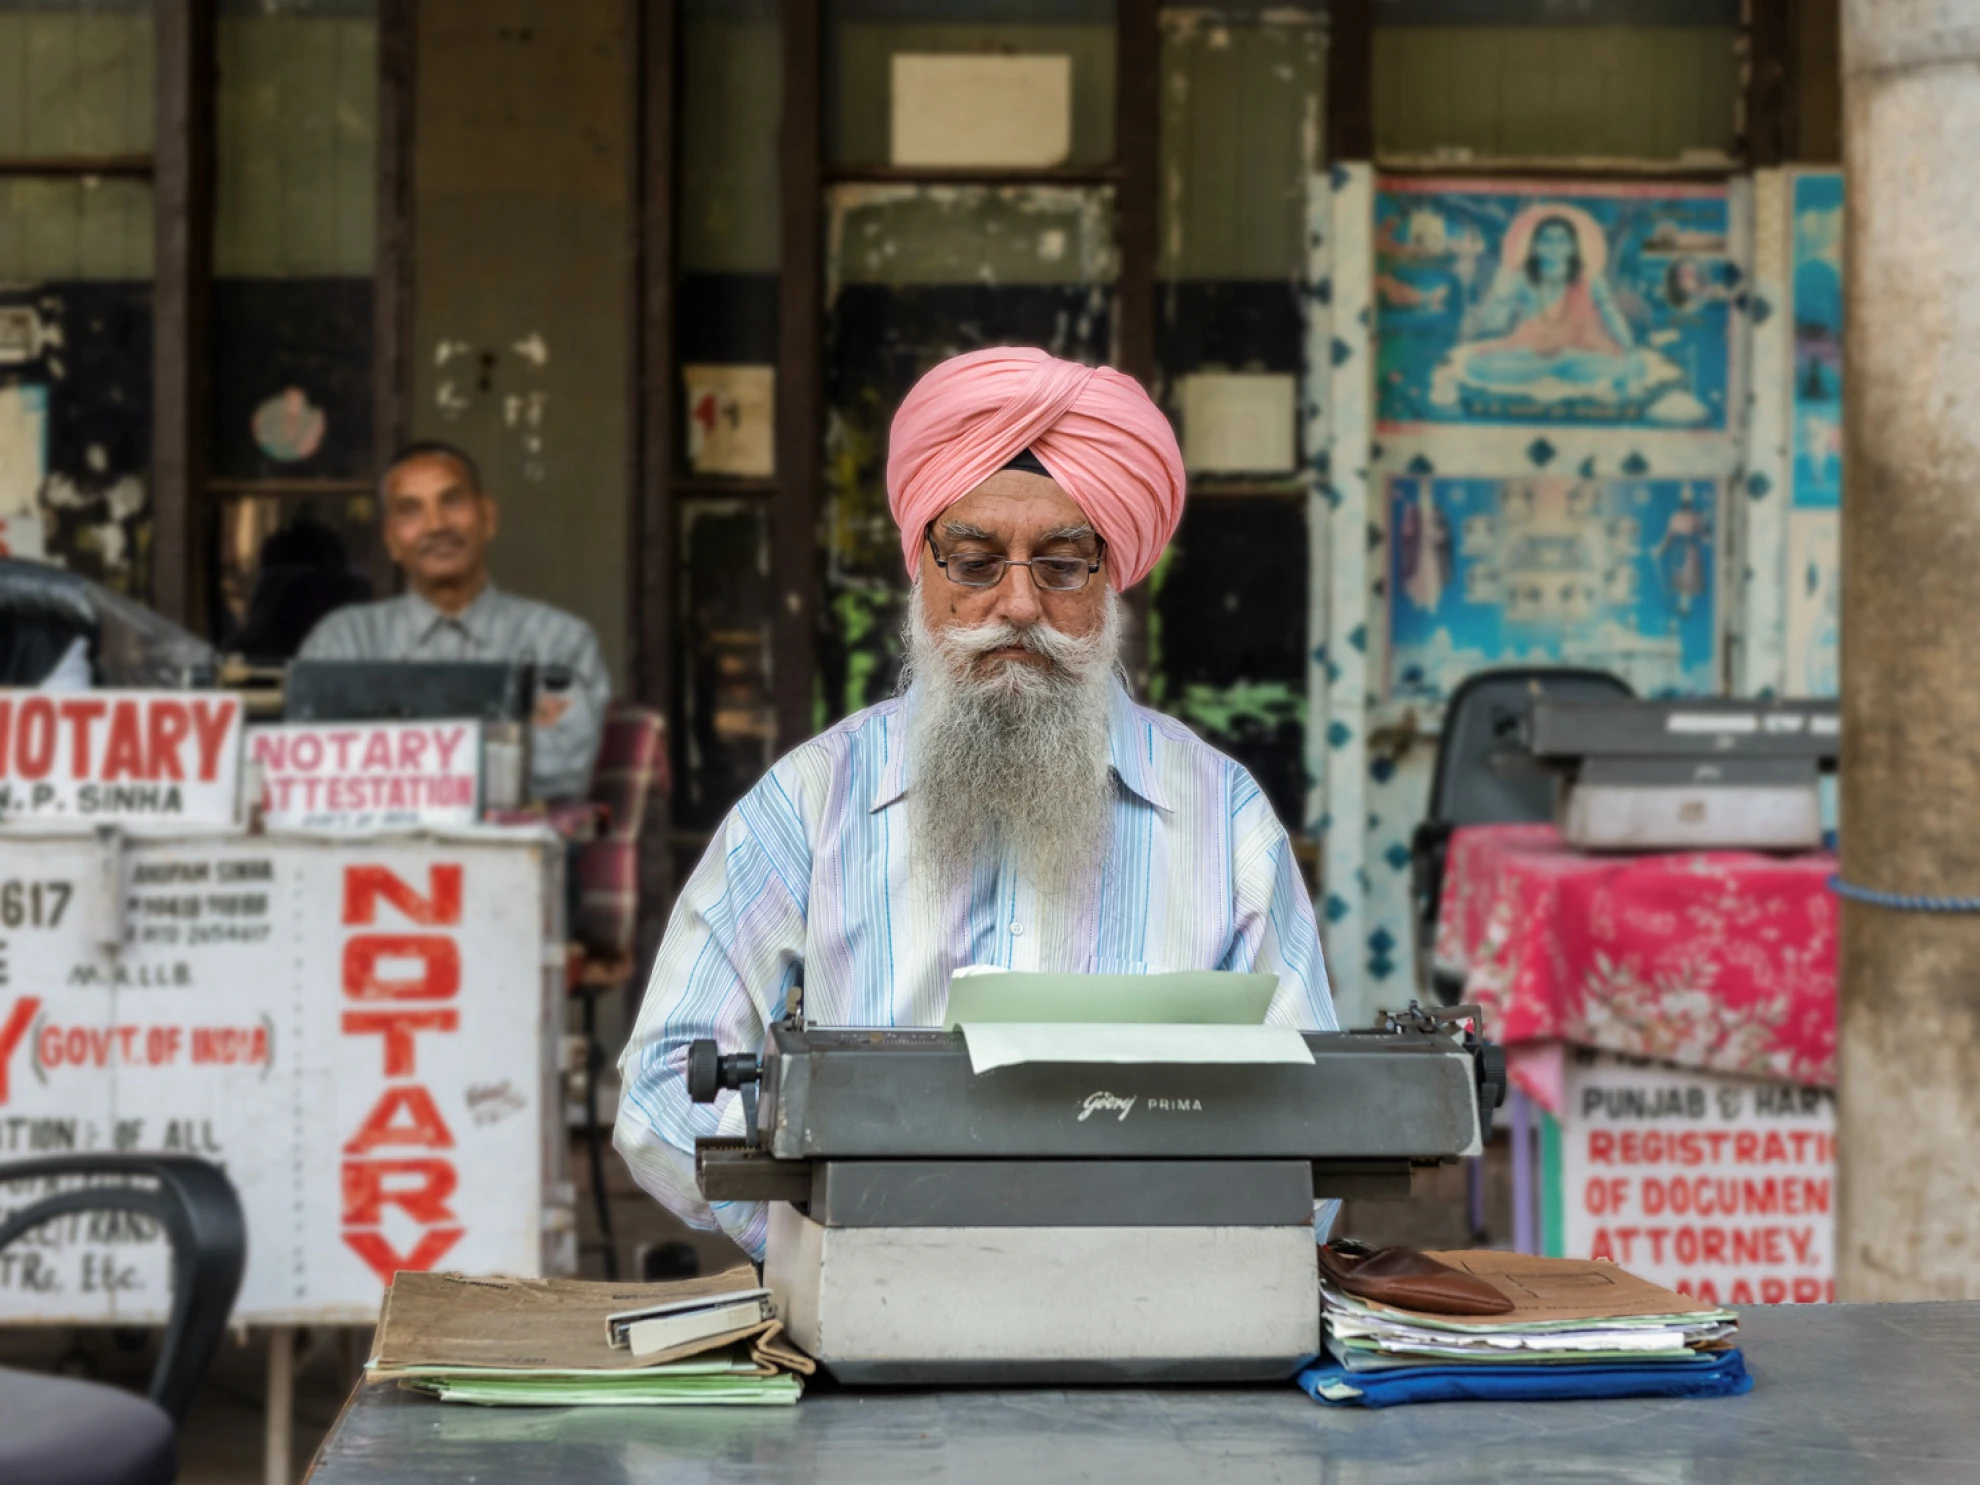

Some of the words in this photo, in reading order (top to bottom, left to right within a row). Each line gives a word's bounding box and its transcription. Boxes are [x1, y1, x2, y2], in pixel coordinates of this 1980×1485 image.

[0, 696, 237, 782] OTARY
[254, 727, 466, 773] NOTARY
[77, 784, 183, 814] SINHA
[340, 862, 467, 1287] NOTARY
[1148, 1099, 1202, 1111] PRIMA
[1582, 1086, 1706, 1120] PUNJAB
[164, 1118, 220, 1151] ALL
[1585, 1176, 1630, 1217] OF
[1641, 1175, 1830, 1217] DOCUMEN
